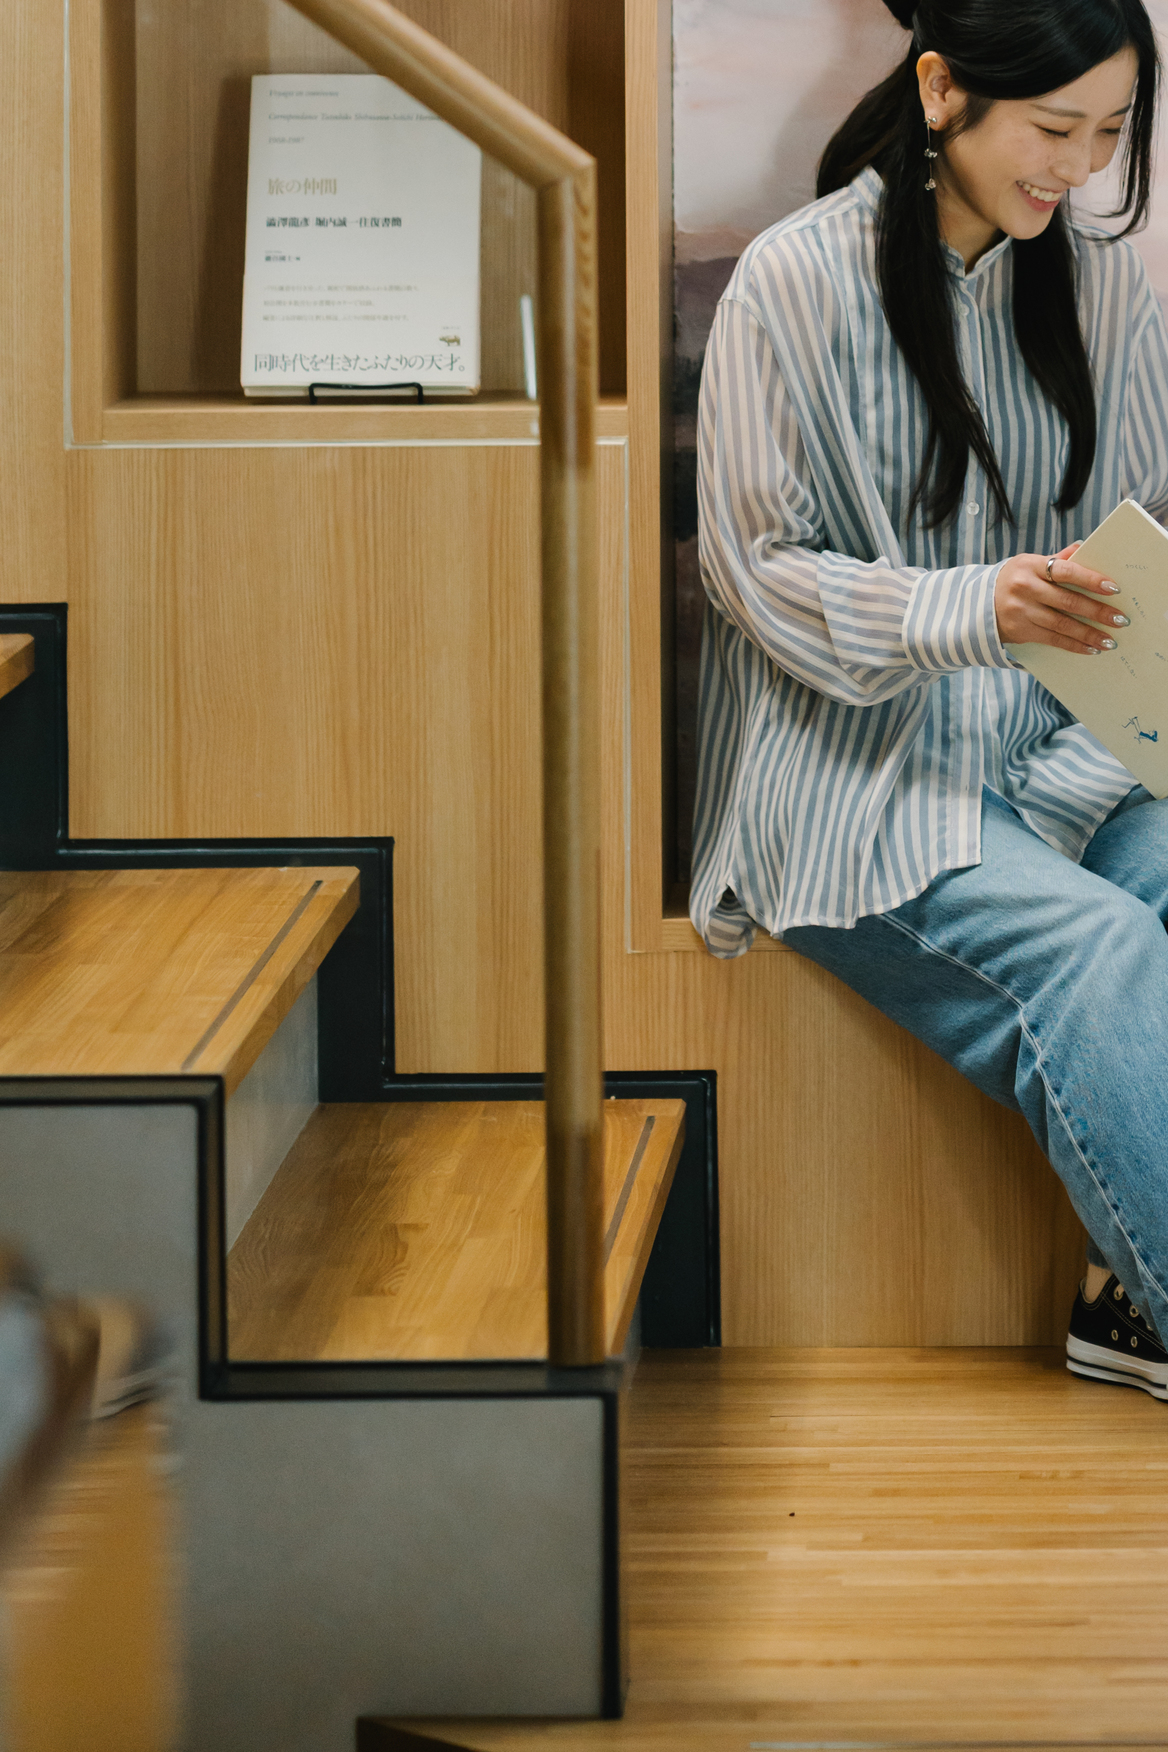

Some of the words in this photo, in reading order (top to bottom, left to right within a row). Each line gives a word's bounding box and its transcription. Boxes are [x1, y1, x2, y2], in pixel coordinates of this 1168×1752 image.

[268, 178, 338, 196] 旅の仲間
[254, 352, 466, 373] 同時代を生きたふたりの天才。
